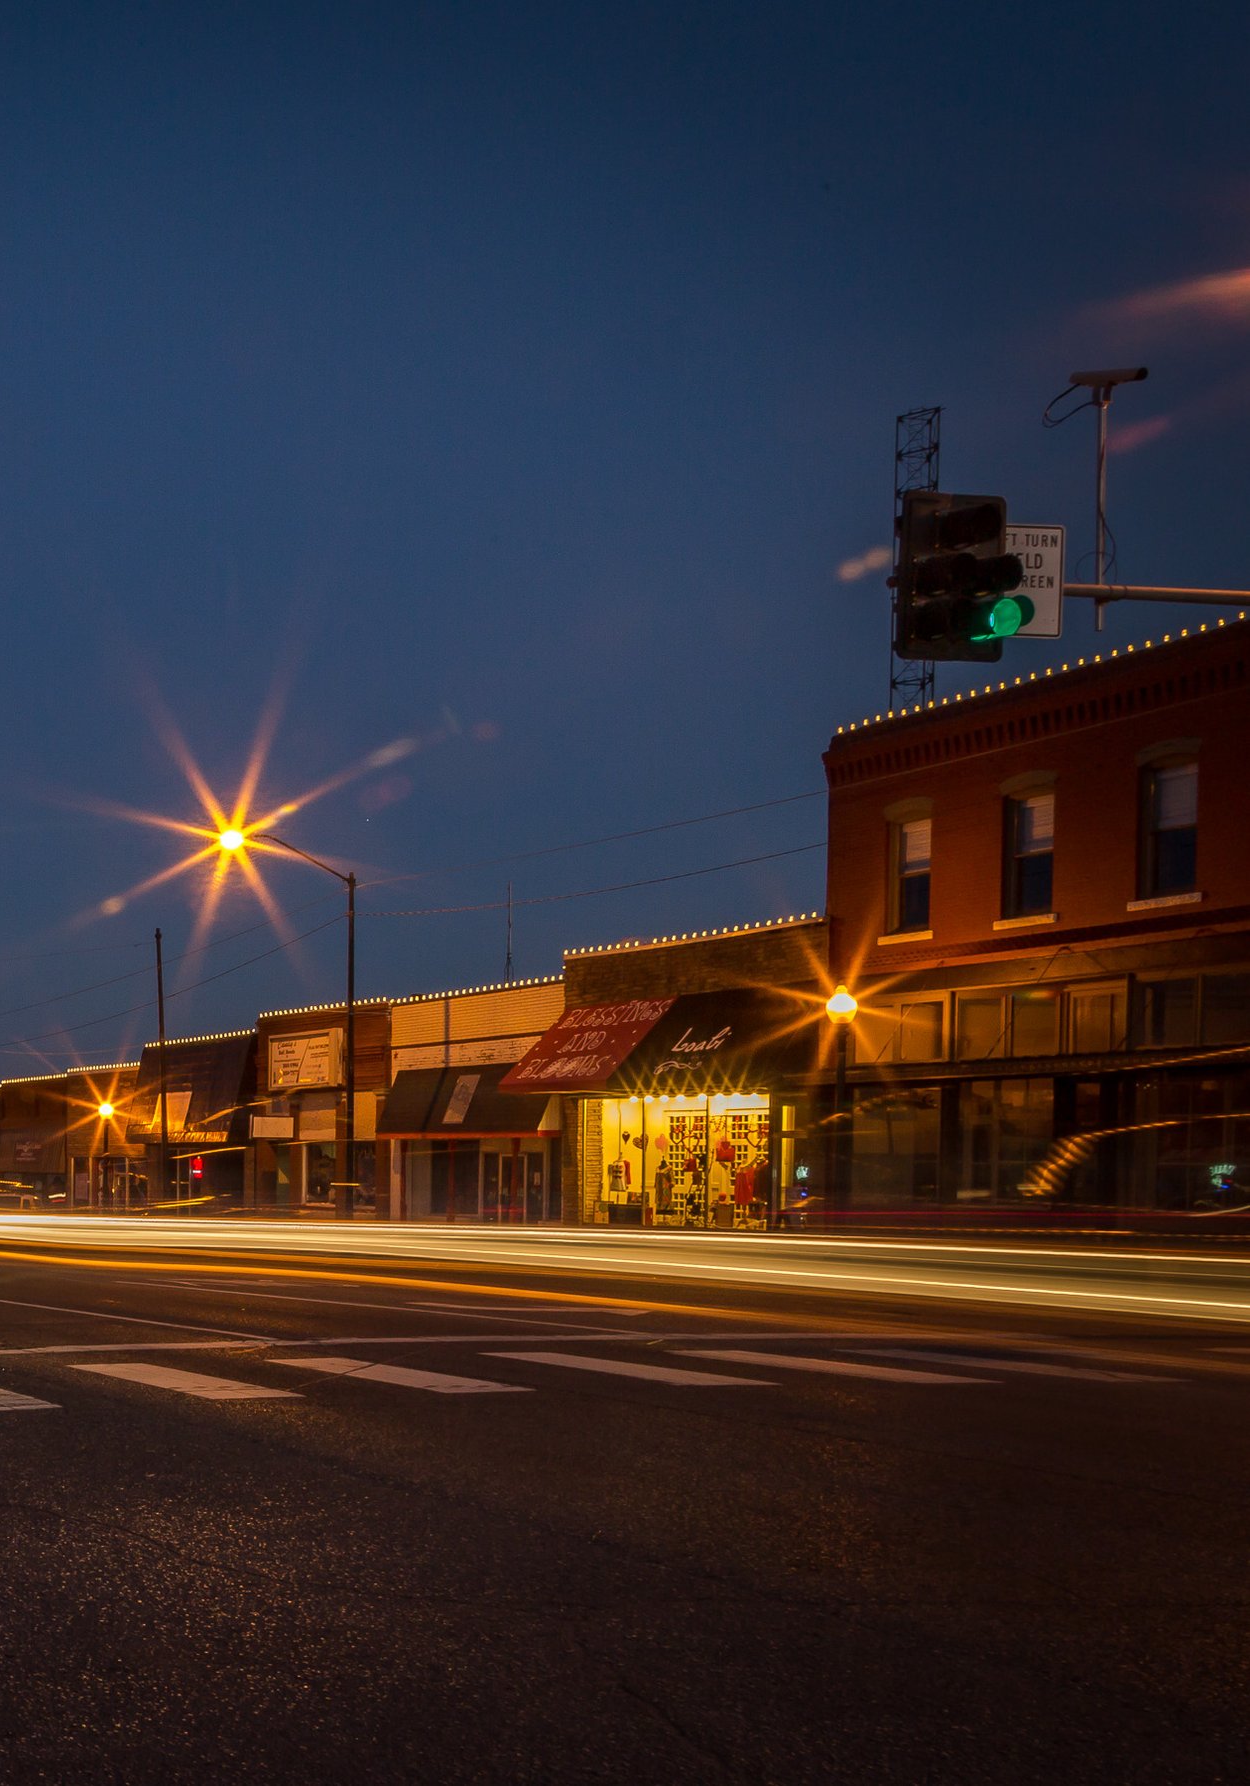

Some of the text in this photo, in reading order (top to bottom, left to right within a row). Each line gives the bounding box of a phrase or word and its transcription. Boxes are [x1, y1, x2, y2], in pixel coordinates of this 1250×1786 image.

[1025, 533, 1058, 548] TURN
[558, 999, 670, 1030] BLESSINGS
[557, 1030, 607, 1054] AND
[517, 1054, 609, 1080] BLOOMS
